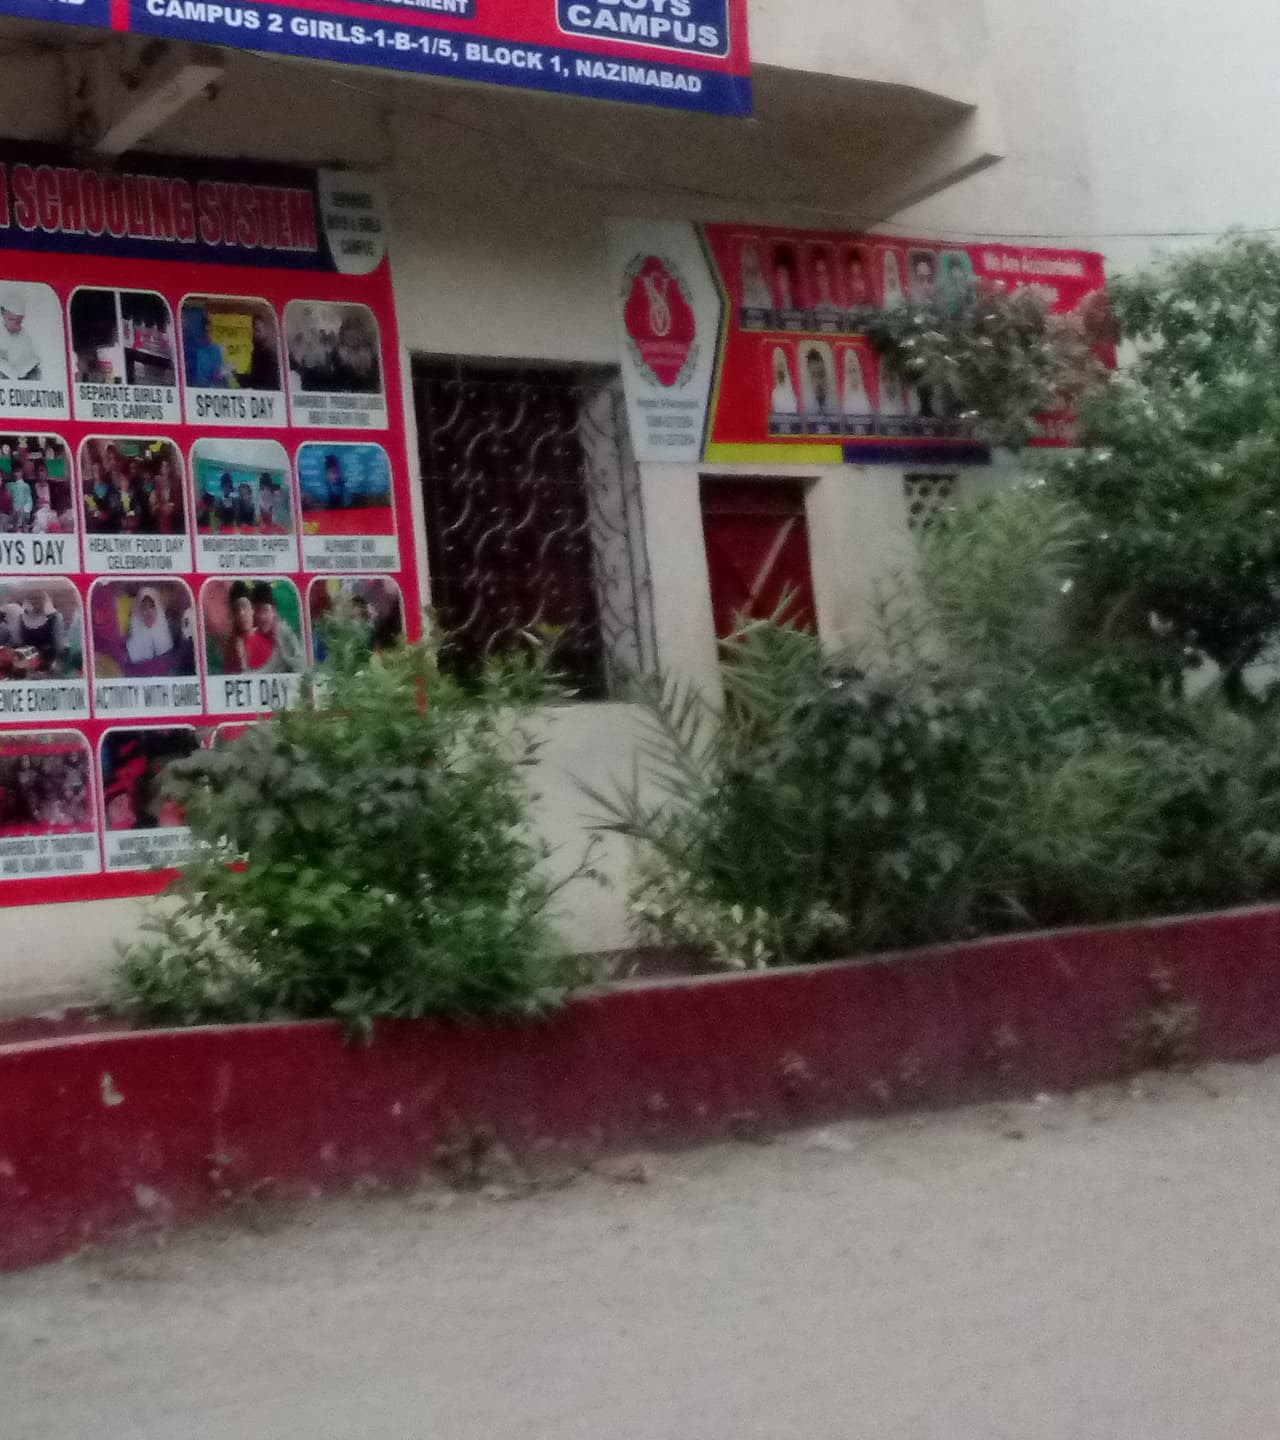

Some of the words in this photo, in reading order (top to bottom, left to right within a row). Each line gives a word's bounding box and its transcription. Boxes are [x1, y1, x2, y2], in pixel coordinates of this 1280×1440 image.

[567, 4, 719, 48] CAMPUS
[267, 13, 283, 33] 2
[291, 17, 459, 62] GIRLS-1-B-1/5,
[466, 43, 542, 70] BLOCK
[550, 55, 569, 77] 1,
[577, 59, 702, 93] NAZIMABAD
[13, 163, 196, 244] SCHOOLING
[197, 180, 318, 252] SYSTEM
[9, 388, 65, 409] EDUCATION
[79, 385, 130, 402] SEPARATE
[133, 387, 163, 403] GIRLS
[196, 394, 246, 419] SPORTS
[250, 396, 274, 419] DAY
[121, 403, 164, 420] CAMPUS
[32, 540, 65, 565] DAY
[89, 537, 132, 553] HEALTHY
[136, 538, 162, 553] FOOD
[165, 538, 184, 553] DAY
[108, 555, 173, 570] CELEBRATION
[27, 687, 85, 712] EXHIBITION
[225, 679, 252, 707] PET
[259, 677, 289, 709] DAY
